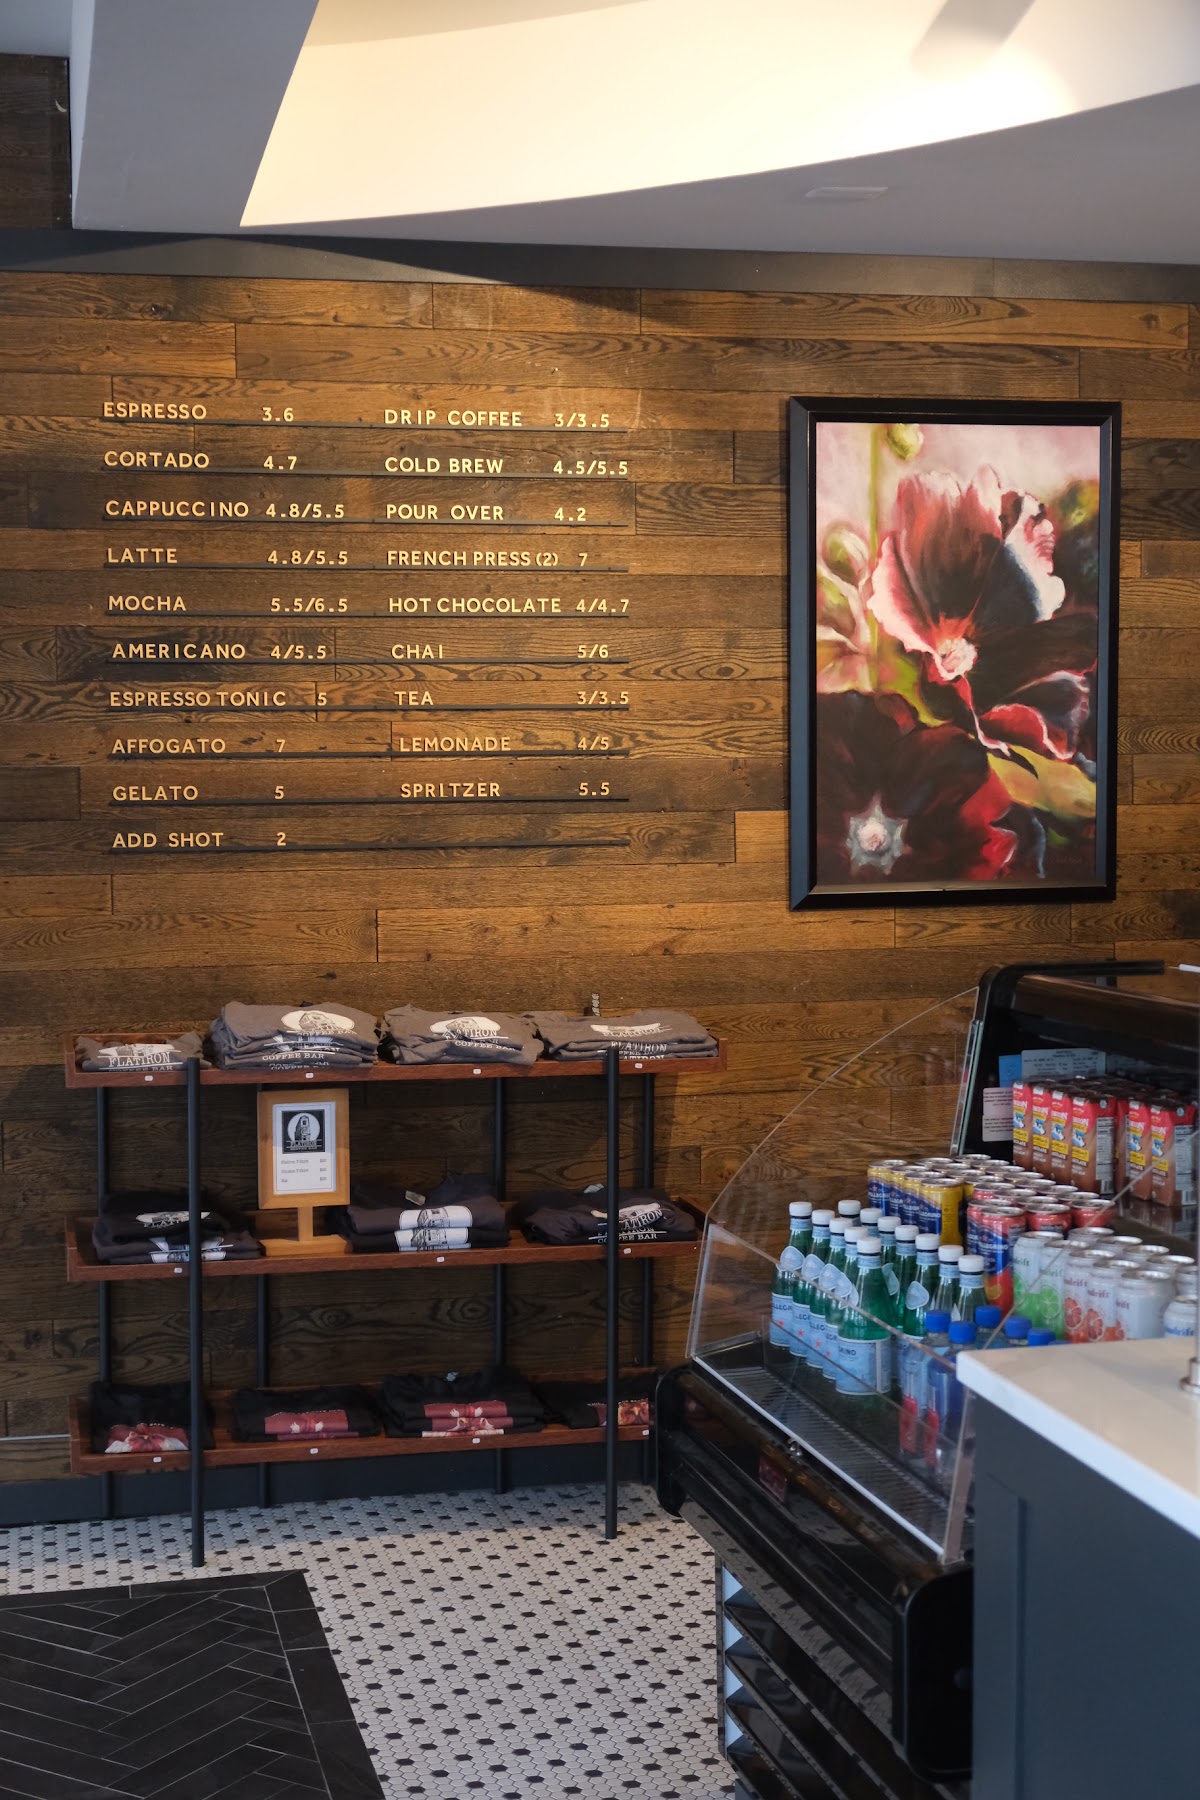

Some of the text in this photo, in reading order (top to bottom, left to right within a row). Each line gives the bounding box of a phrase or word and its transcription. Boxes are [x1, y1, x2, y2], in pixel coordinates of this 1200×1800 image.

[103, 402, 294, 422] ESPRESSO 3.6
[384, 409, 610, 428] DRIP COFFEE 3/3.5
[104, 451, 297, 470] CORTADO 4.7
[384, 457, 628, 476] COLD BREW 4.5/5.5
[105, 500, 345, 518] CAPPUCCINO 4.8/5.5
[386, 504, 587, 522] POUR OVER 4.2
[107, 548, 348, 565] LATTE 4.8/5.5
[387, 550, 588, 567] FRENCH PRESS (2) 7
[108, 595, 348, 613] MOCHA 5.5/6.5
[389, 597, 630, 613] HOT CHOCOLATE 4/4.7
[112, 643, 327, 660] AMERICANO 4/5.5
[391, 644, 609, 660] CHAI 5/6
[110, 691, 327, 707] ESPRESSO TONIC 5
[394, 691, 629, 706] TEA 3/3.5
[112, 738, 286, 754] AFFOGATO 7
[400, 736, 609, 752] LEMONADE 4/5
[112, 785, 285, 801] GELATO 5
[579, 782, 610, 796] 5.5
[112, 832, 287, 848] ADD SHOT 2
[108, 1051, 172, 1068] FLATIRON
[262, 1052, 325, 1061] COFFEE BAR
[624, 1209, 663, 1230] ATIRON
